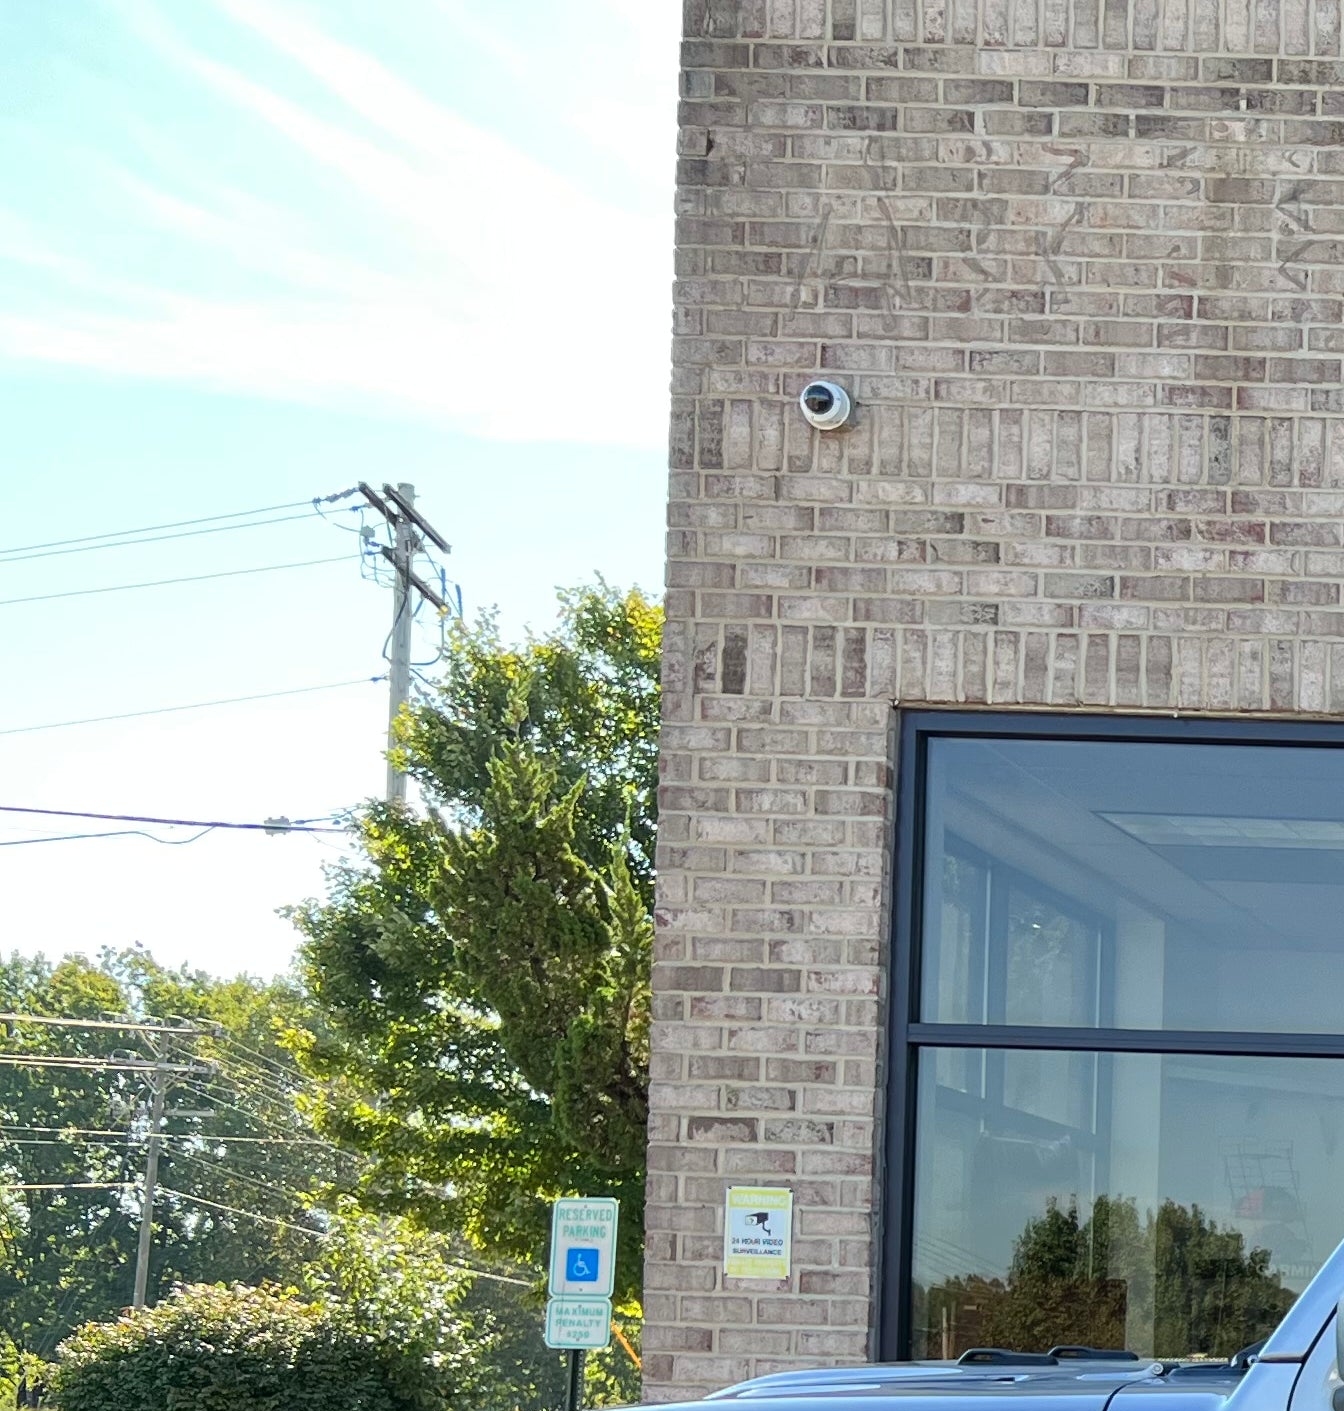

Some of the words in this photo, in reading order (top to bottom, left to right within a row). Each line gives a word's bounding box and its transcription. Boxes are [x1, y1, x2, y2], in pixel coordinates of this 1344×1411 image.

[732, 1192, 787, 1206] WARNING
[558, 1208, 612, 1222] RESERVED
[562, 1225, 607, 1239] PARKING
[731, 1237, 741, 1246] 24
[741, 1238, 761, 1246] HOUR
[761, 1238, 784, 1247] VIDEO
[731, 1247, 782, 1256] SURVEILLANCE
[555, 1307, 604, 1317] MAXIMUM
[555, 1319, 602, 1328] PENALTY
